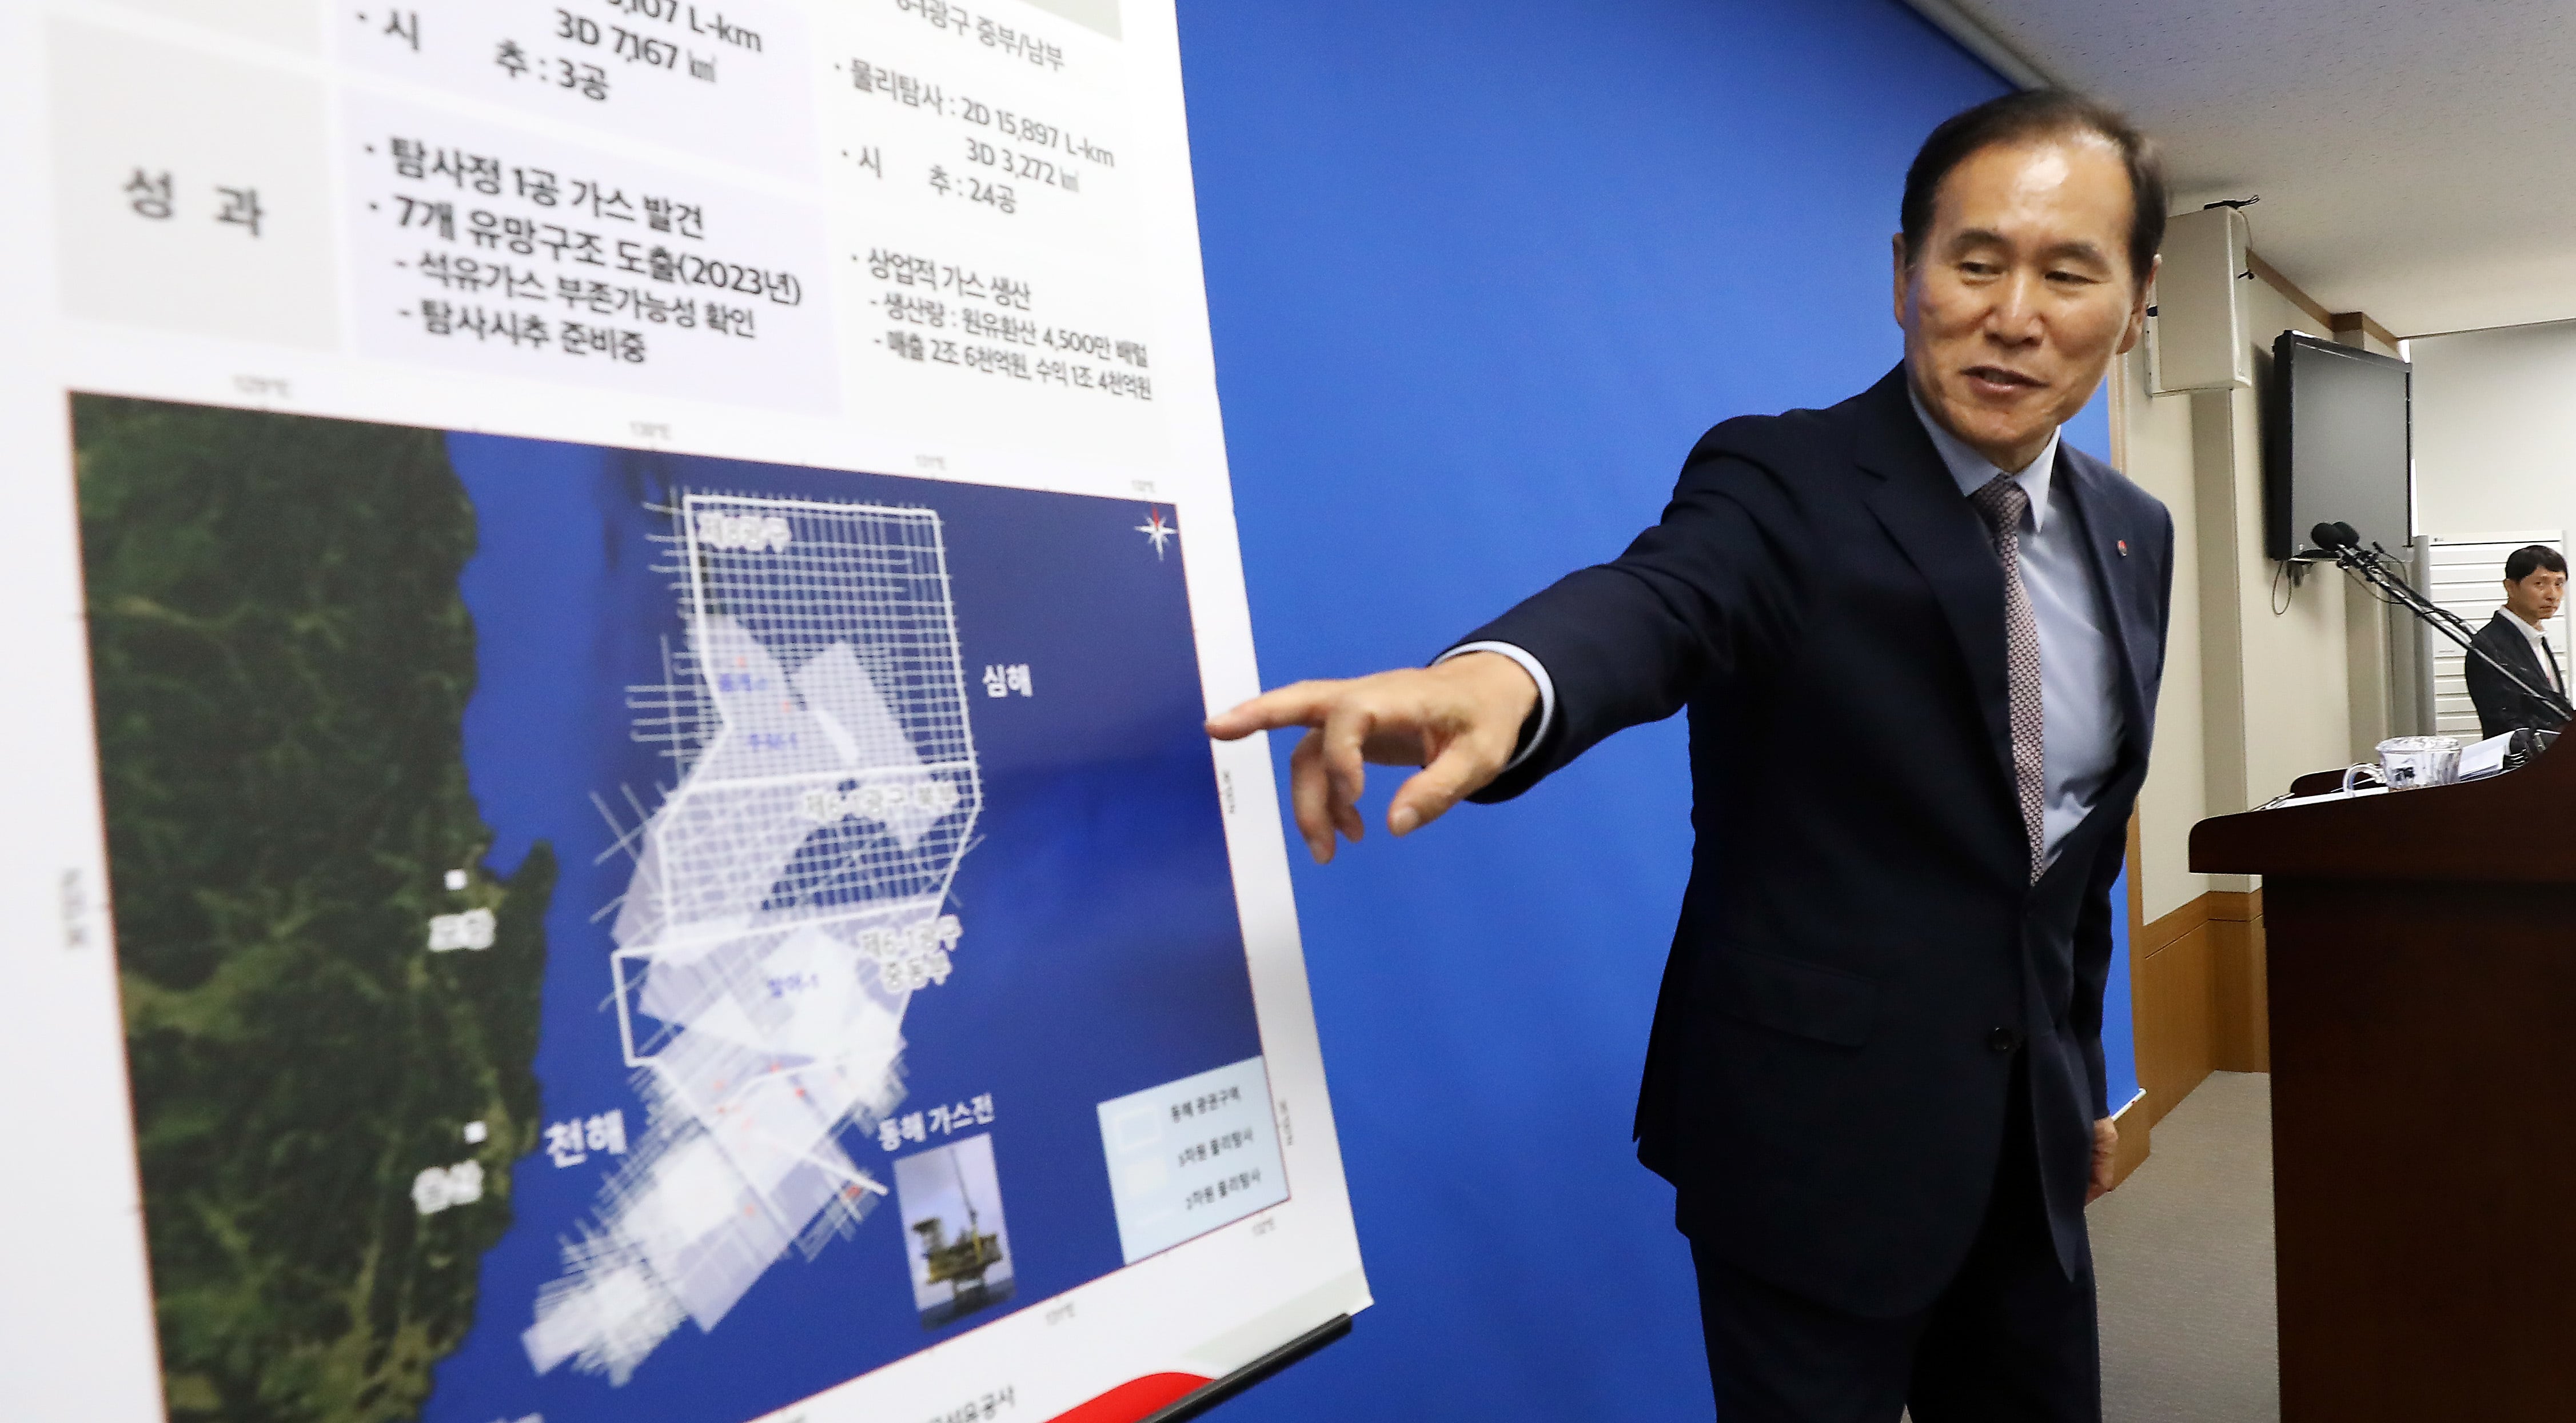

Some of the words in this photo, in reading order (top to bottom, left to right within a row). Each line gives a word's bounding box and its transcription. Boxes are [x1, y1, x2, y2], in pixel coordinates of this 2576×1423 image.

[381, 8, 420, 51] 시
[494, 38, 530, 78] 추
[557, 57, 610, 101] 3공
[556, 8, 599, 45] 3D
[610, 25, 677, 69] 7,167
[689, 6, 762, 52] L-km
[976, 15, 1064, 71] 중부/남부
[851, 59, 943, 115] 물리탐사
[961, 97, 991, 126] 2D
[996, 109, 1058, 149] 15,897
[1066, 133, 1115, 167] L-km
[392, 137, 501, 195] 탐사정
[512, 167, 560, 206] 1공
[571, 180, 636, 222] 가스
[643, 195, 704, 240] 발견
[859, 146, 882, 178] 시
[929, 164, 951, 195] 추
[968, 177, 1016, 214] 24공
[966, 137, 995, 166] 3D
[1002, 149, 1056, 186] 3,272
[122, 167, 174, 219] 성
[213, 184, 265, 238] 과
[395, 195, 456, 241] 7개
[468, 210, 607, 267] 유망구조
[616, 242, 802, 307] 도출(2023년)
[868, 247, 938, 291] 상업적
[943, 267, 986, 298] 가스
[990, 275, 1032, 311] 생산
[417, 250, 547, 301] 석유가스
[556, 275, 697, 329] 부존가능성
[705, 301, 756, 339] 확인
[883, 291, 945, 328] 생산량
[963, 307, 1036, 347] 원유환산
[1042, 327, 1112, 361] 4,500만
[421, 298, 551, 348] 탐사시추
[560, 322, 647, 364] 준비중
[887, 330, 924, 362] 매출
[930, 338, 960, 365] 2조
[1036, 357, 1070, 388] 수익
[1071, 365, 1095, 389] 1조
[1098, 370, 1153, 401] 4천억원
[982, 663, 1033, 698] 심해
[544, 1108, 627, 1169] 천해
[878, 1110, 927, 1152] 동해
[927, 1092, 995, 1136] 가스전
